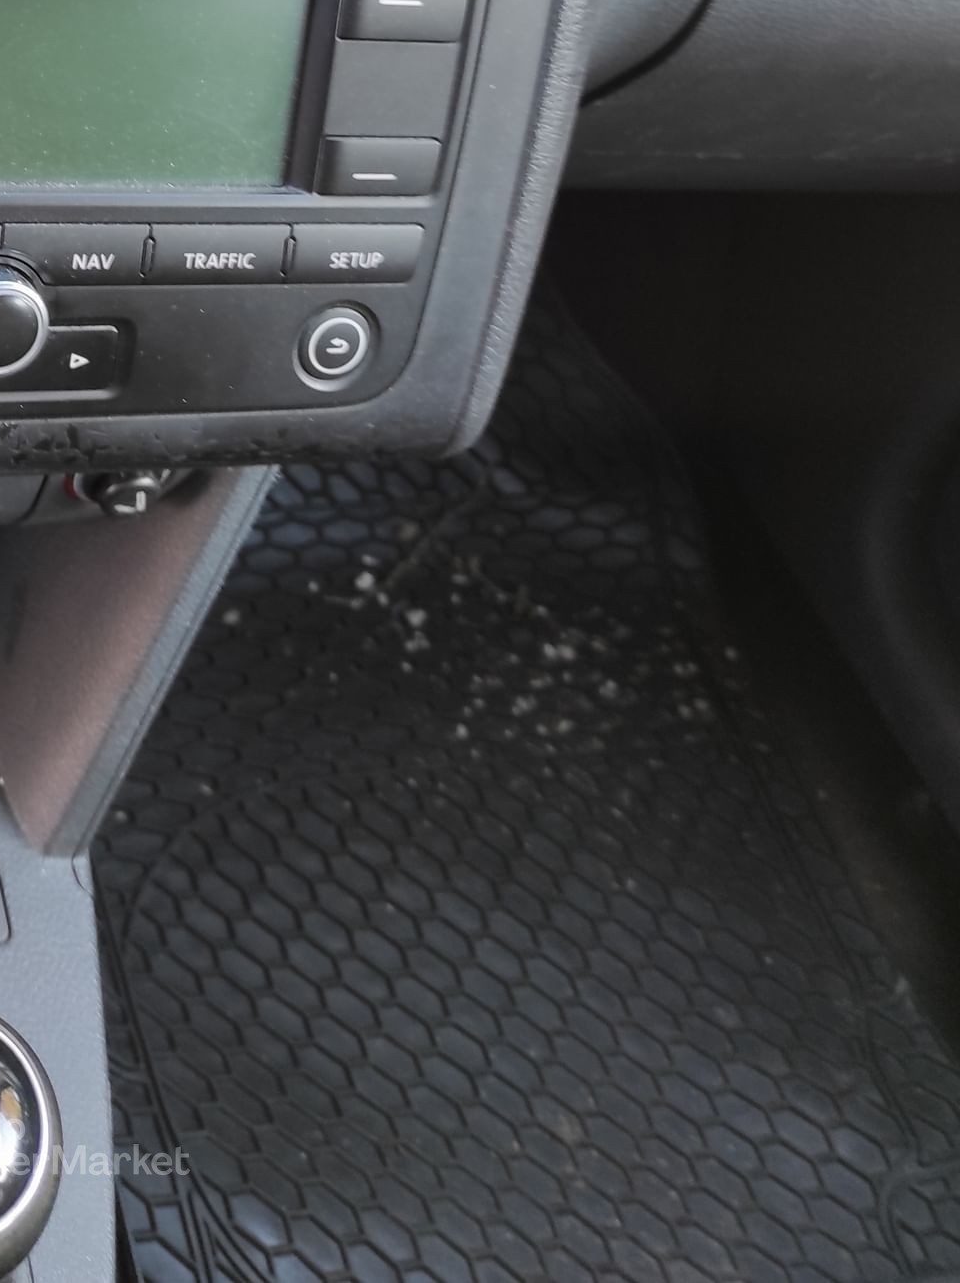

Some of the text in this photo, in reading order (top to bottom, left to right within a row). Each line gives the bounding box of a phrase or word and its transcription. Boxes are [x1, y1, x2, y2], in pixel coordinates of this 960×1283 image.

[71, 252, 115, 271] NAV
[183, 252, 257, 270] TRAFFIC
[328, 251, 384, 269] SETUP
